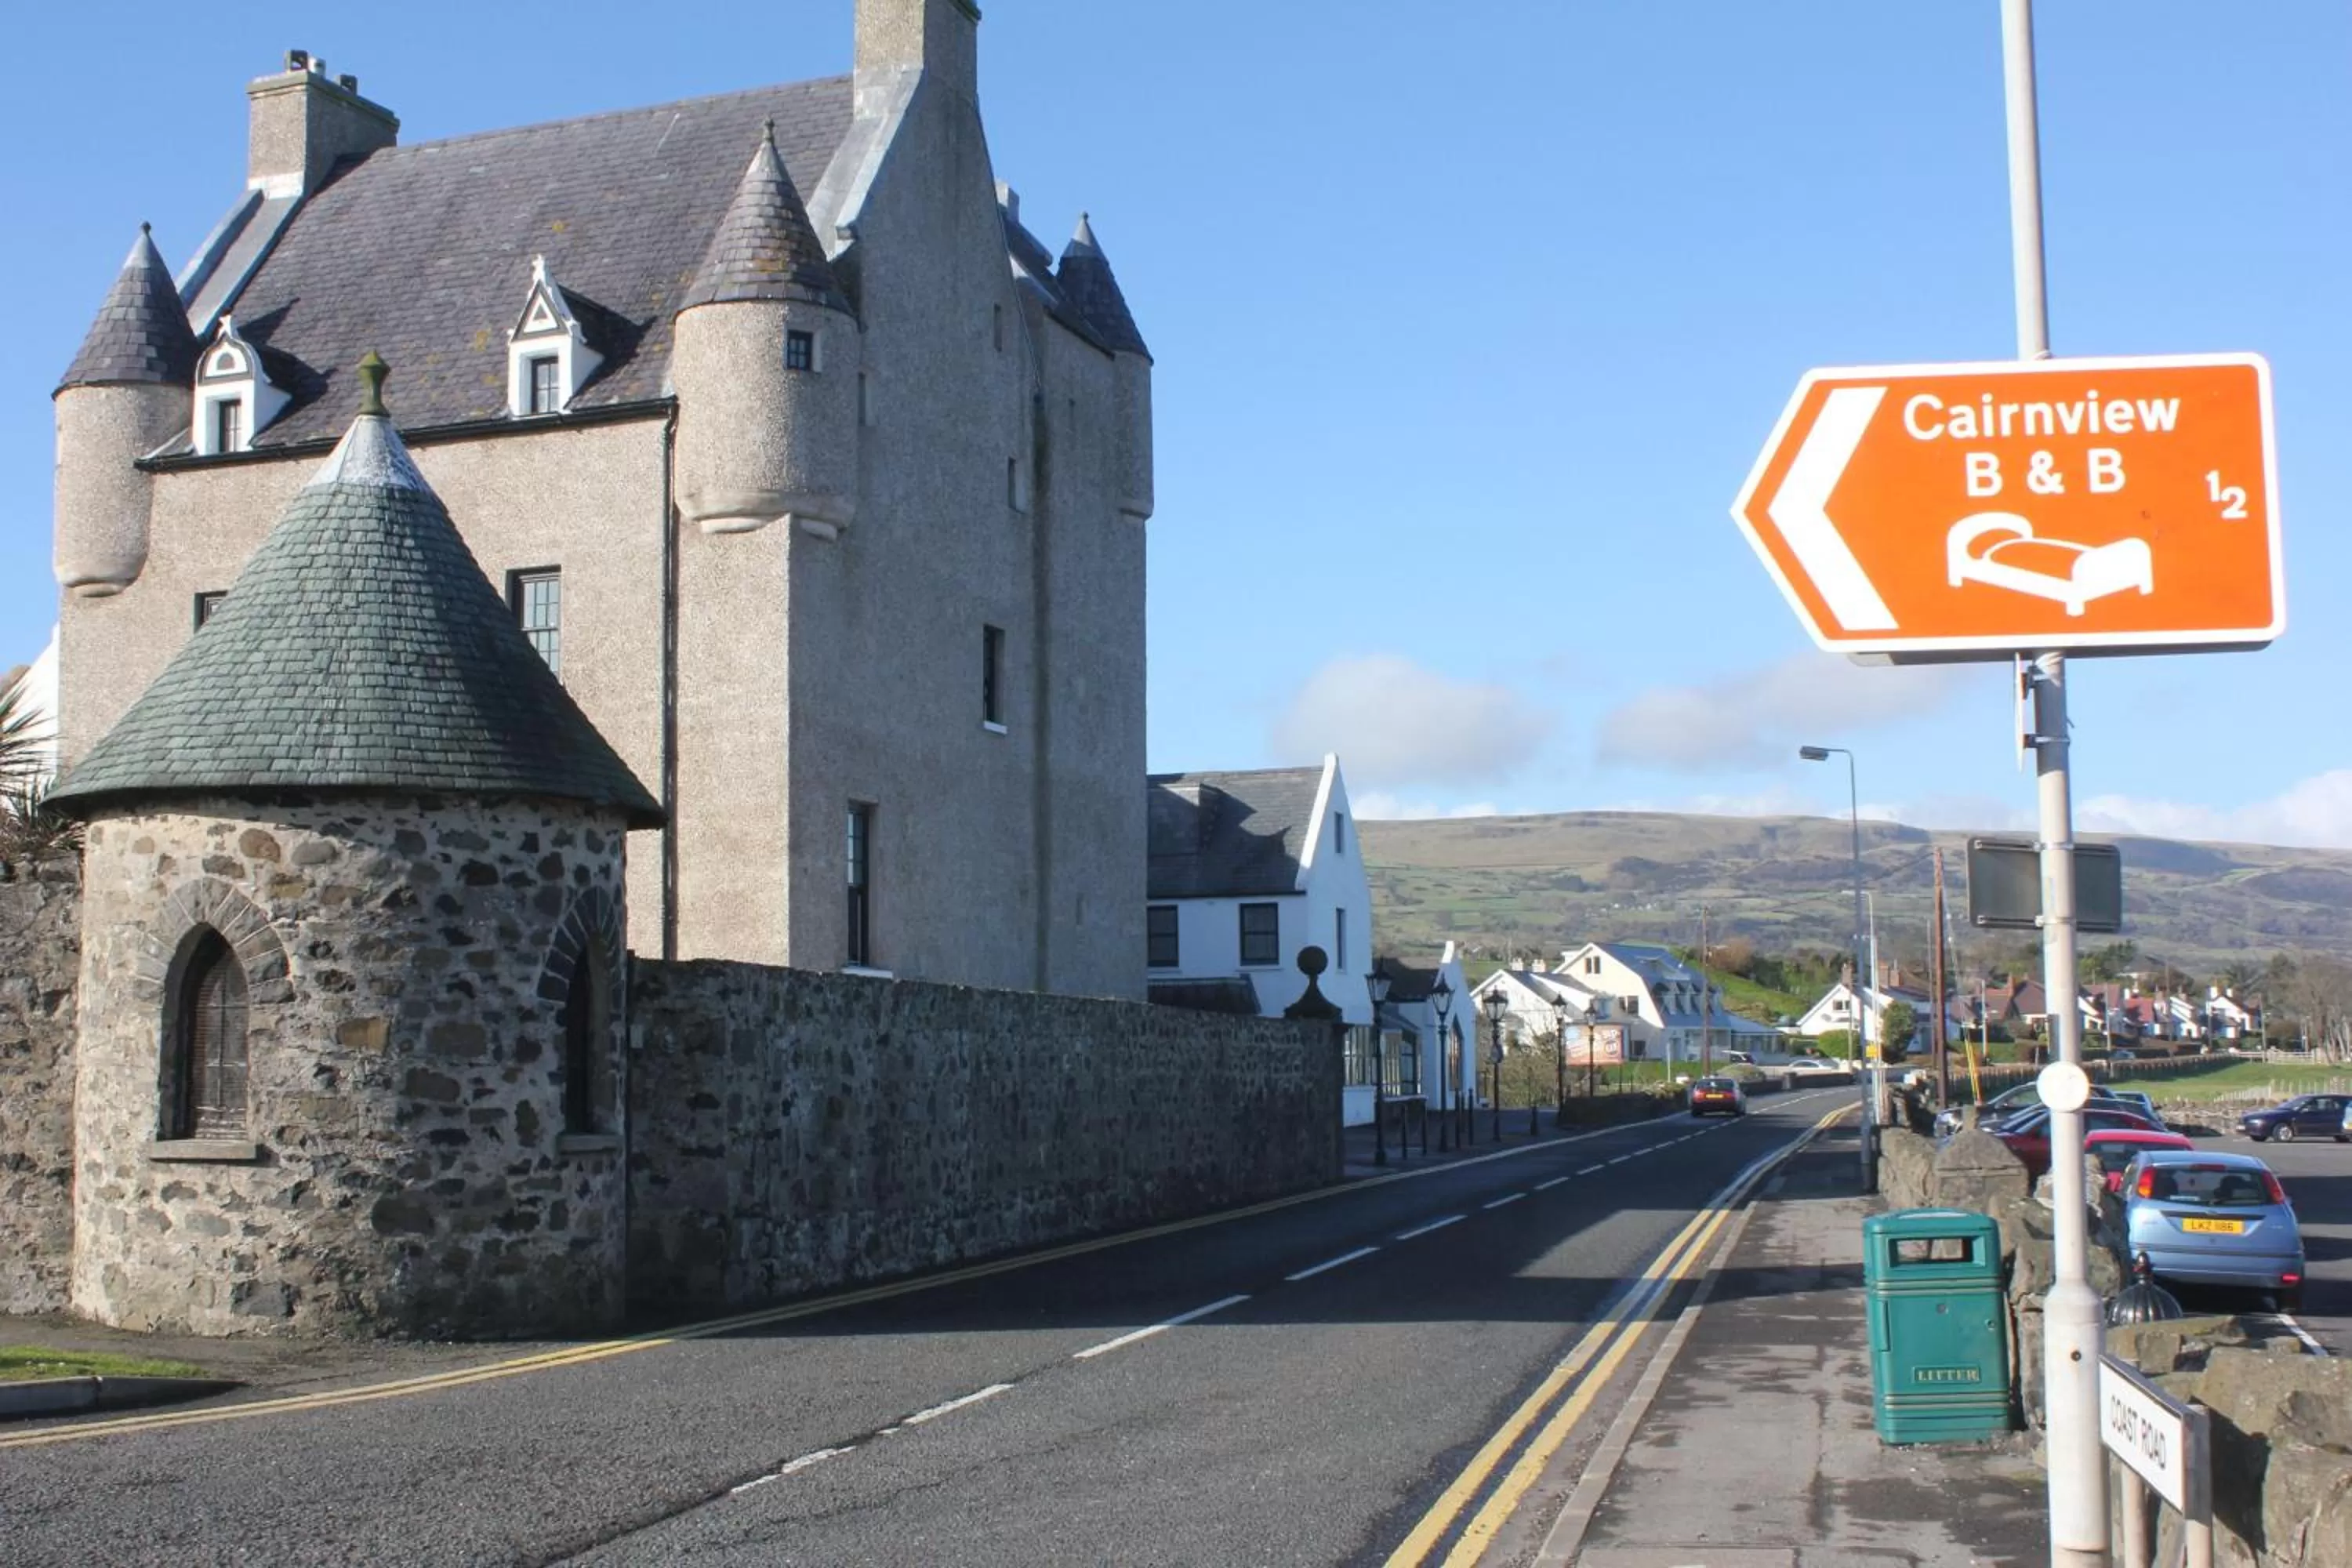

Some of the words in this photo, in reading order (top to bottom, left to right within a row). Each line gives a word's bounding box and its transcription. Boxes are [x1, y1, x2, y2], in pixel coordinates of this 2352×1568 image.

[1904, 390, 2180, 441] Cairnview
[1965, 452, 2003, 496] B
[2027, 449, 2065, 494] &
[2088, 448, 2126, 493] B
[1918, 1370, 1980, 1381] LITTER
[2111, 1395, 2138, 1445] COAST
[2141, 1417, 2166, 1470] ROAD
